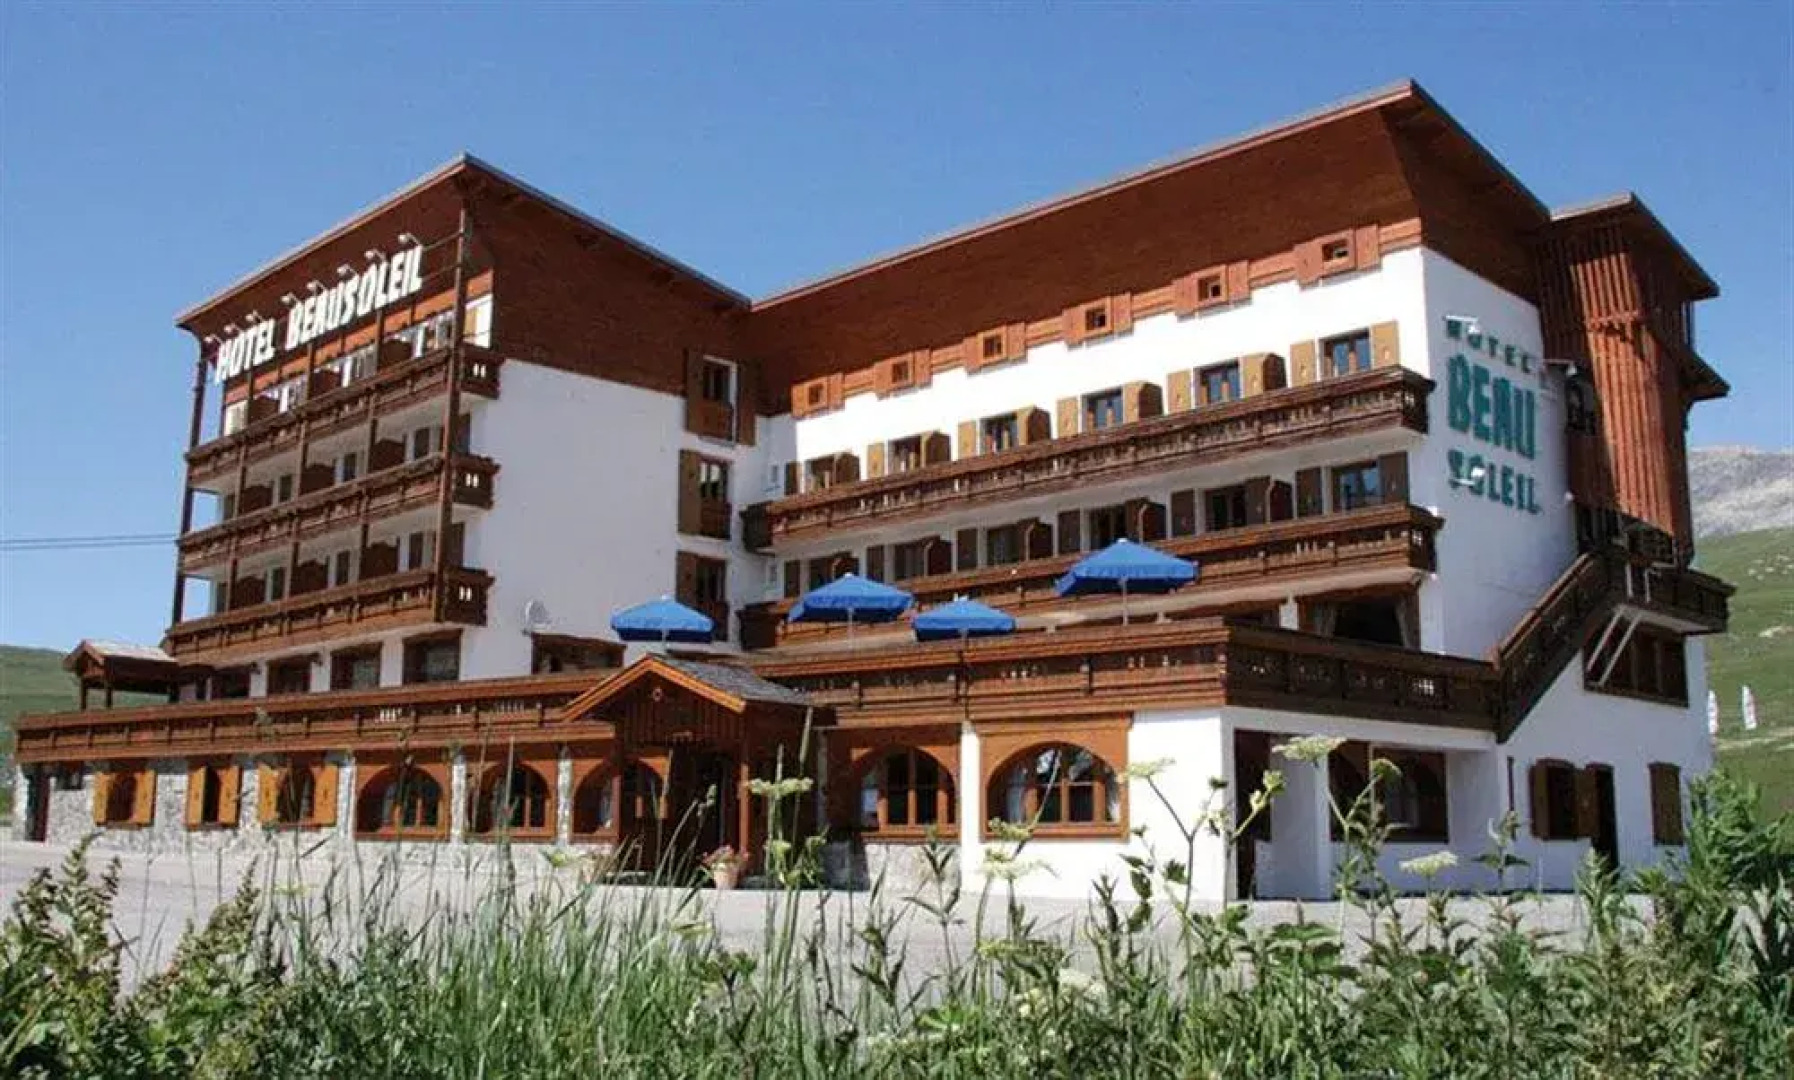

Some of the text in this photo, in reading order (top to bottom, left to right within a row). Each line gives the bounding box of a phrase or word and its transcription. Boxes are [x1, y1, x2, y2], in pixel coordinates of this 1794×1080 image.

[213, 246, 423, 380] HOTEL BEAUSOLEIL
[1447, 320, 1530, 374] HOTEL
[1447, 353, 1535, 460] BEAU
[1448, 450, 1540, 514] SOLEIL
